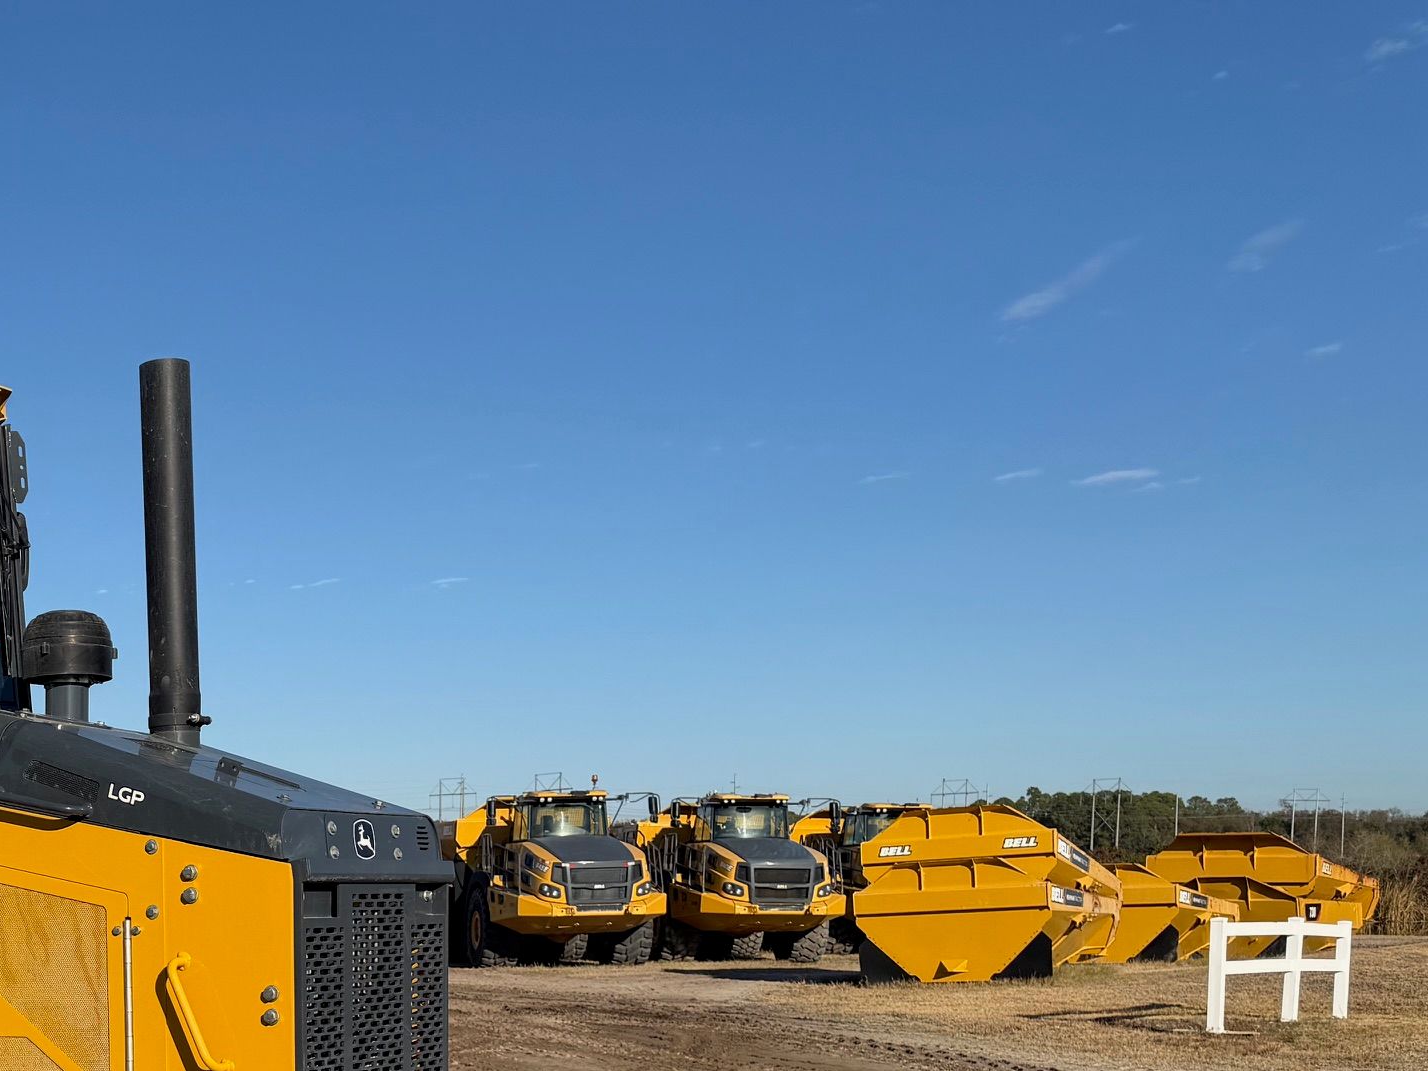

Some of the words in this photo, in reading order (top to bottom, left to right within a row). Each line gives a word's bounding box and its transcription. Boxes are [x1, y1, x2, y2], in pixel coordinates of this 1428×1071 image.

[107, 783, 145, 805] LGP
[879, 845, 911, 857] BELL
[1003, 837, 1038, 848] BELL
[1057, 839, 1071, 860] BELL
[1051, 886, 1065, 903] BELL
